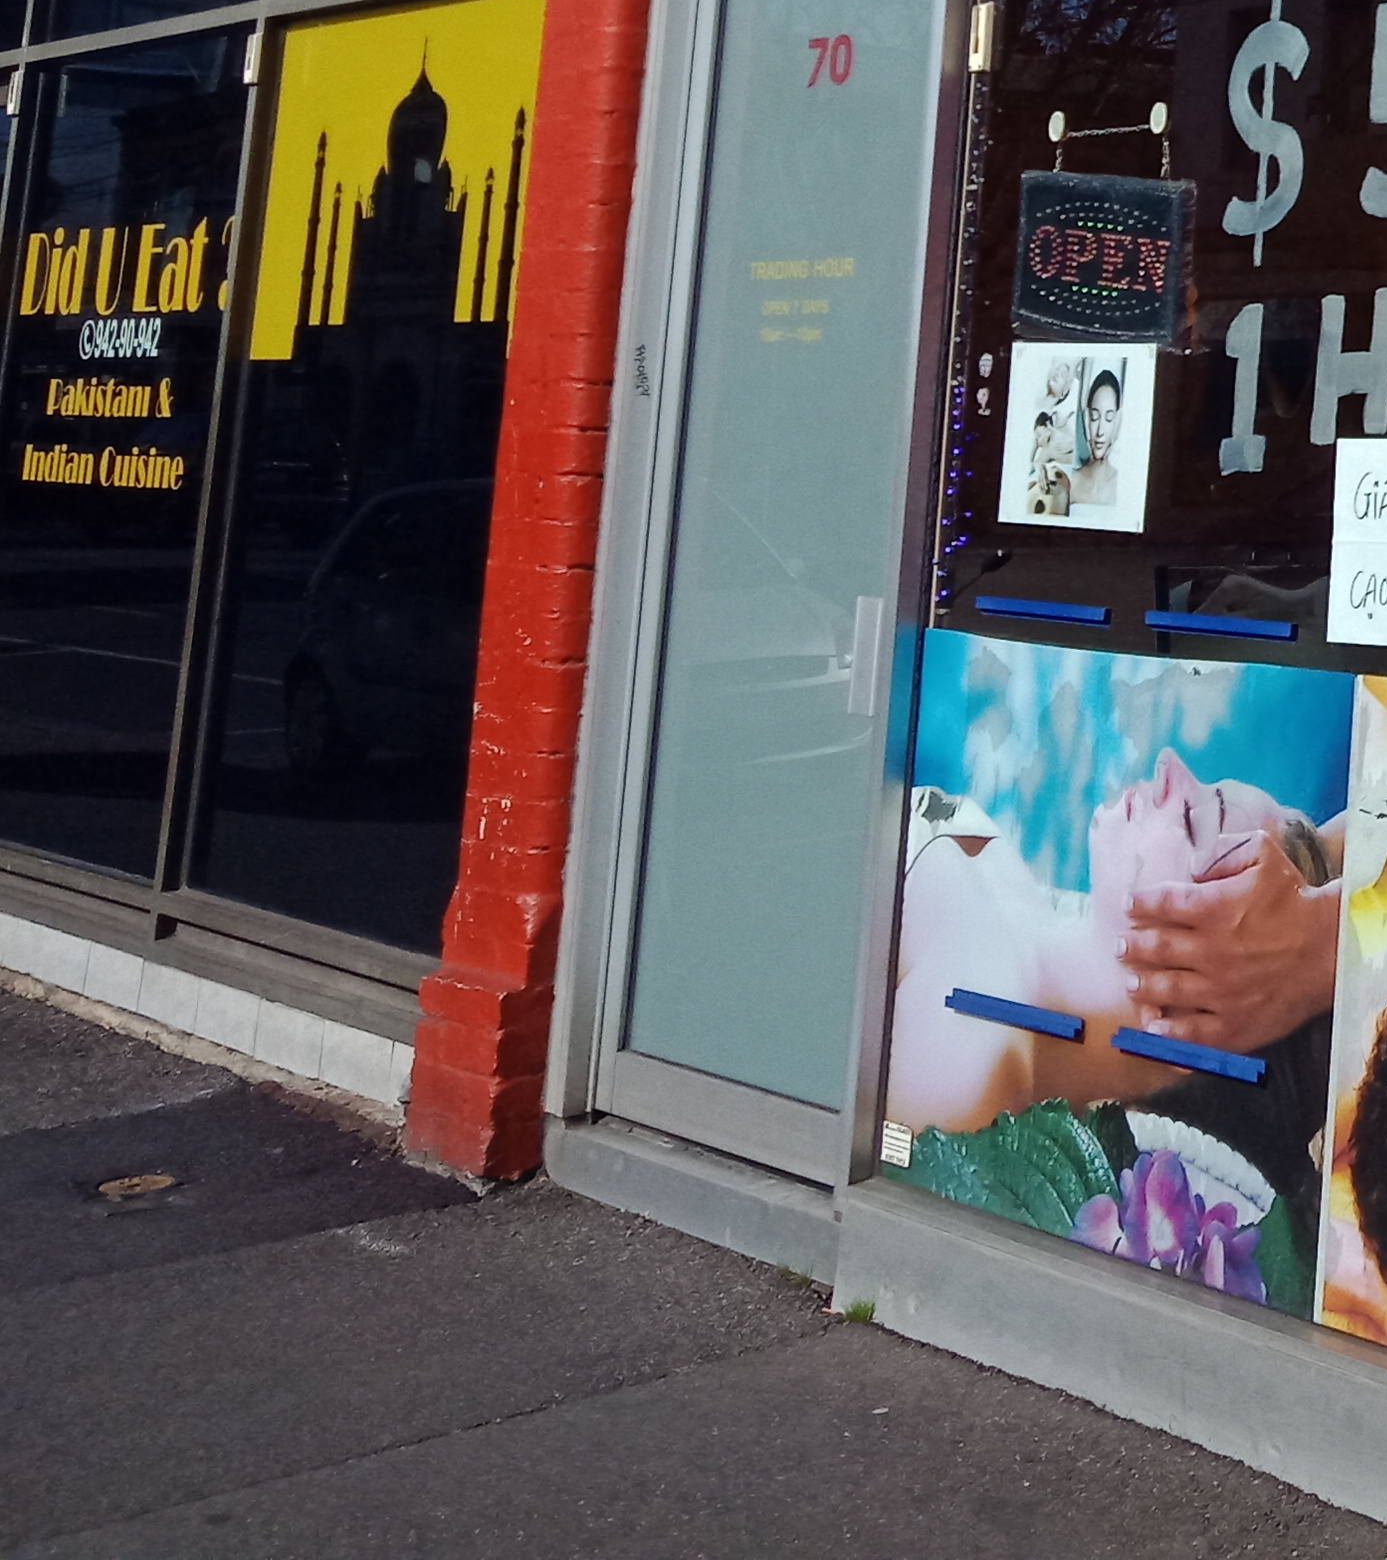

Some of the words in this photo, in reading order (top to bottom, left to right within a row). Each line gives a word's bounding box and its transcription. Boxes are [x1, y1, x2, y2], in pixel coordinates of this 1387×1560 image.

[807, 33, 852, 88] 70
[19, 226, 91, 316] Did
[95, 226, 130, 316] U
[132, 216, 209, 313] Eat
[1028, 225, 1171, 294] OPEN
[155, 377, 175, 418] &
[1219, 303, 1266, 477] 1
[22, 443, 94, 485] Indian
[99, 445, 184, 490] Cuisine
